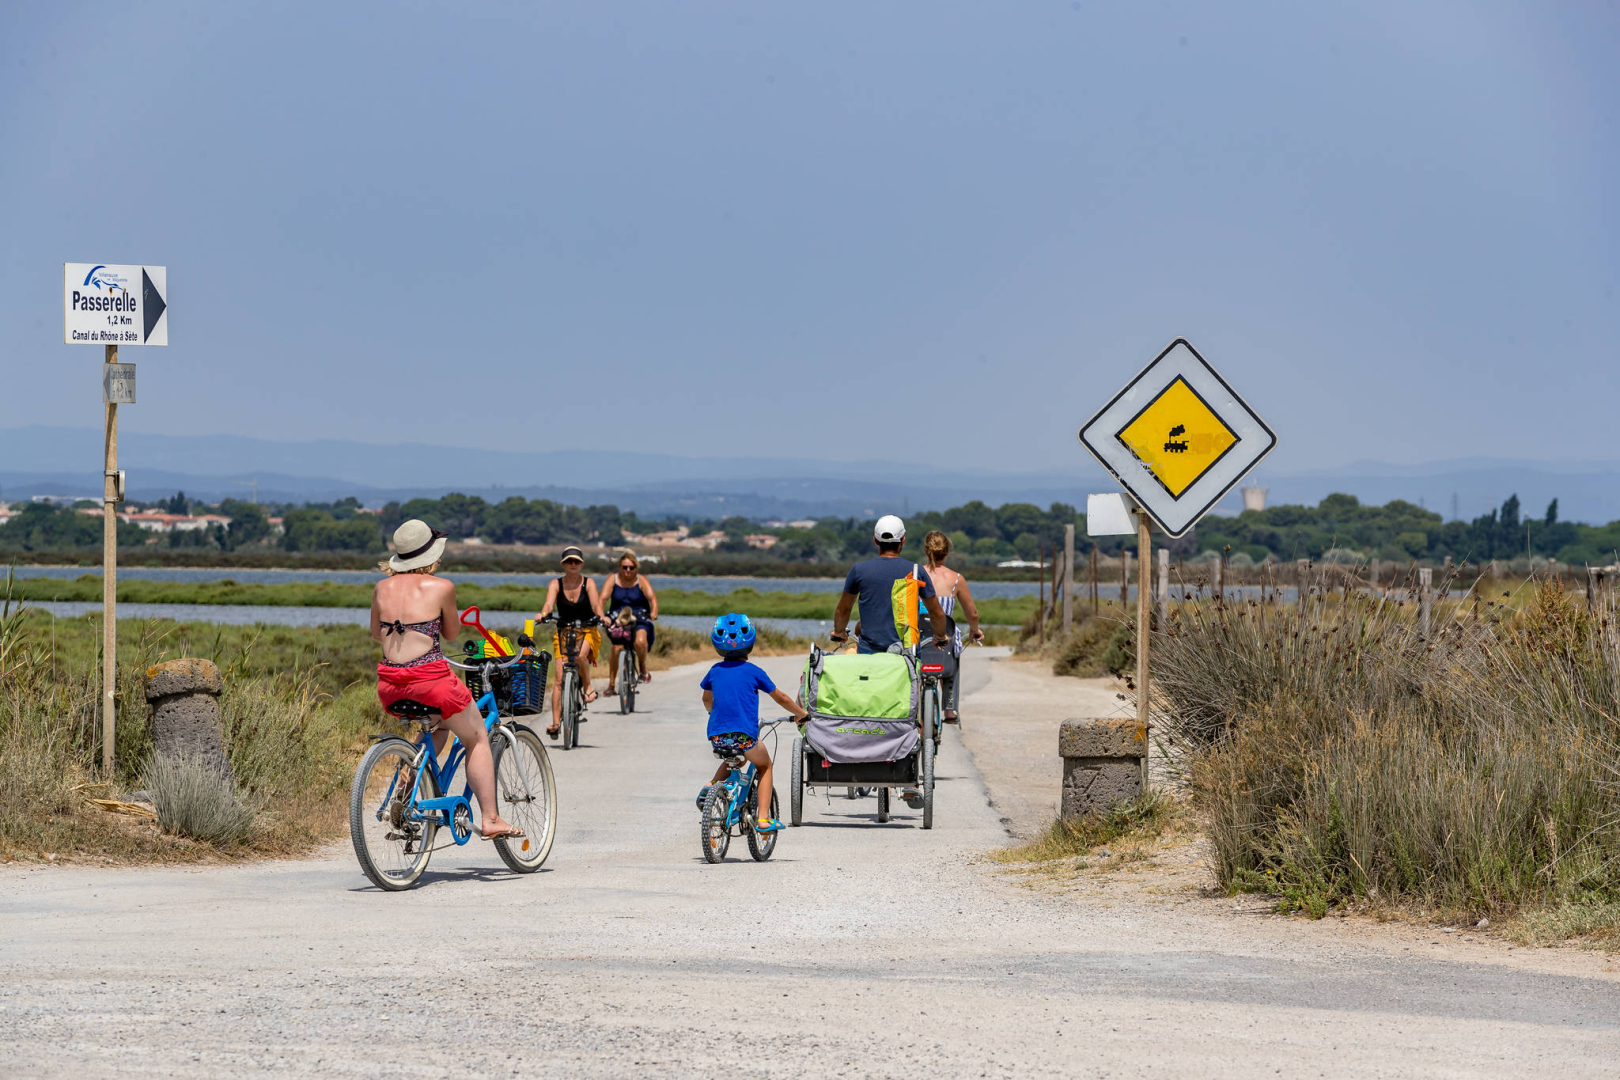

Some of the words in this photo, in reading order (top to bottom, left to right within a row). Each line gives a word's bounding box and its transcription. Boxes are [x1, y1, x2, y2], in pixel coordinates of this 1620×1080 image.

[72, 290, 136, 312] Passerelle
[107, 315, 118, 326] 1,2
[120, 315, 132, 325] Km
[72, 329, 90, 340] Canal
[91, 330, 99, 341] du
[100, 330, 119, 341] Rhône
[119, 330, 124, 341] à
[125, 330, 138, 341] Sète
[835, 727, 887, 735] arcade
